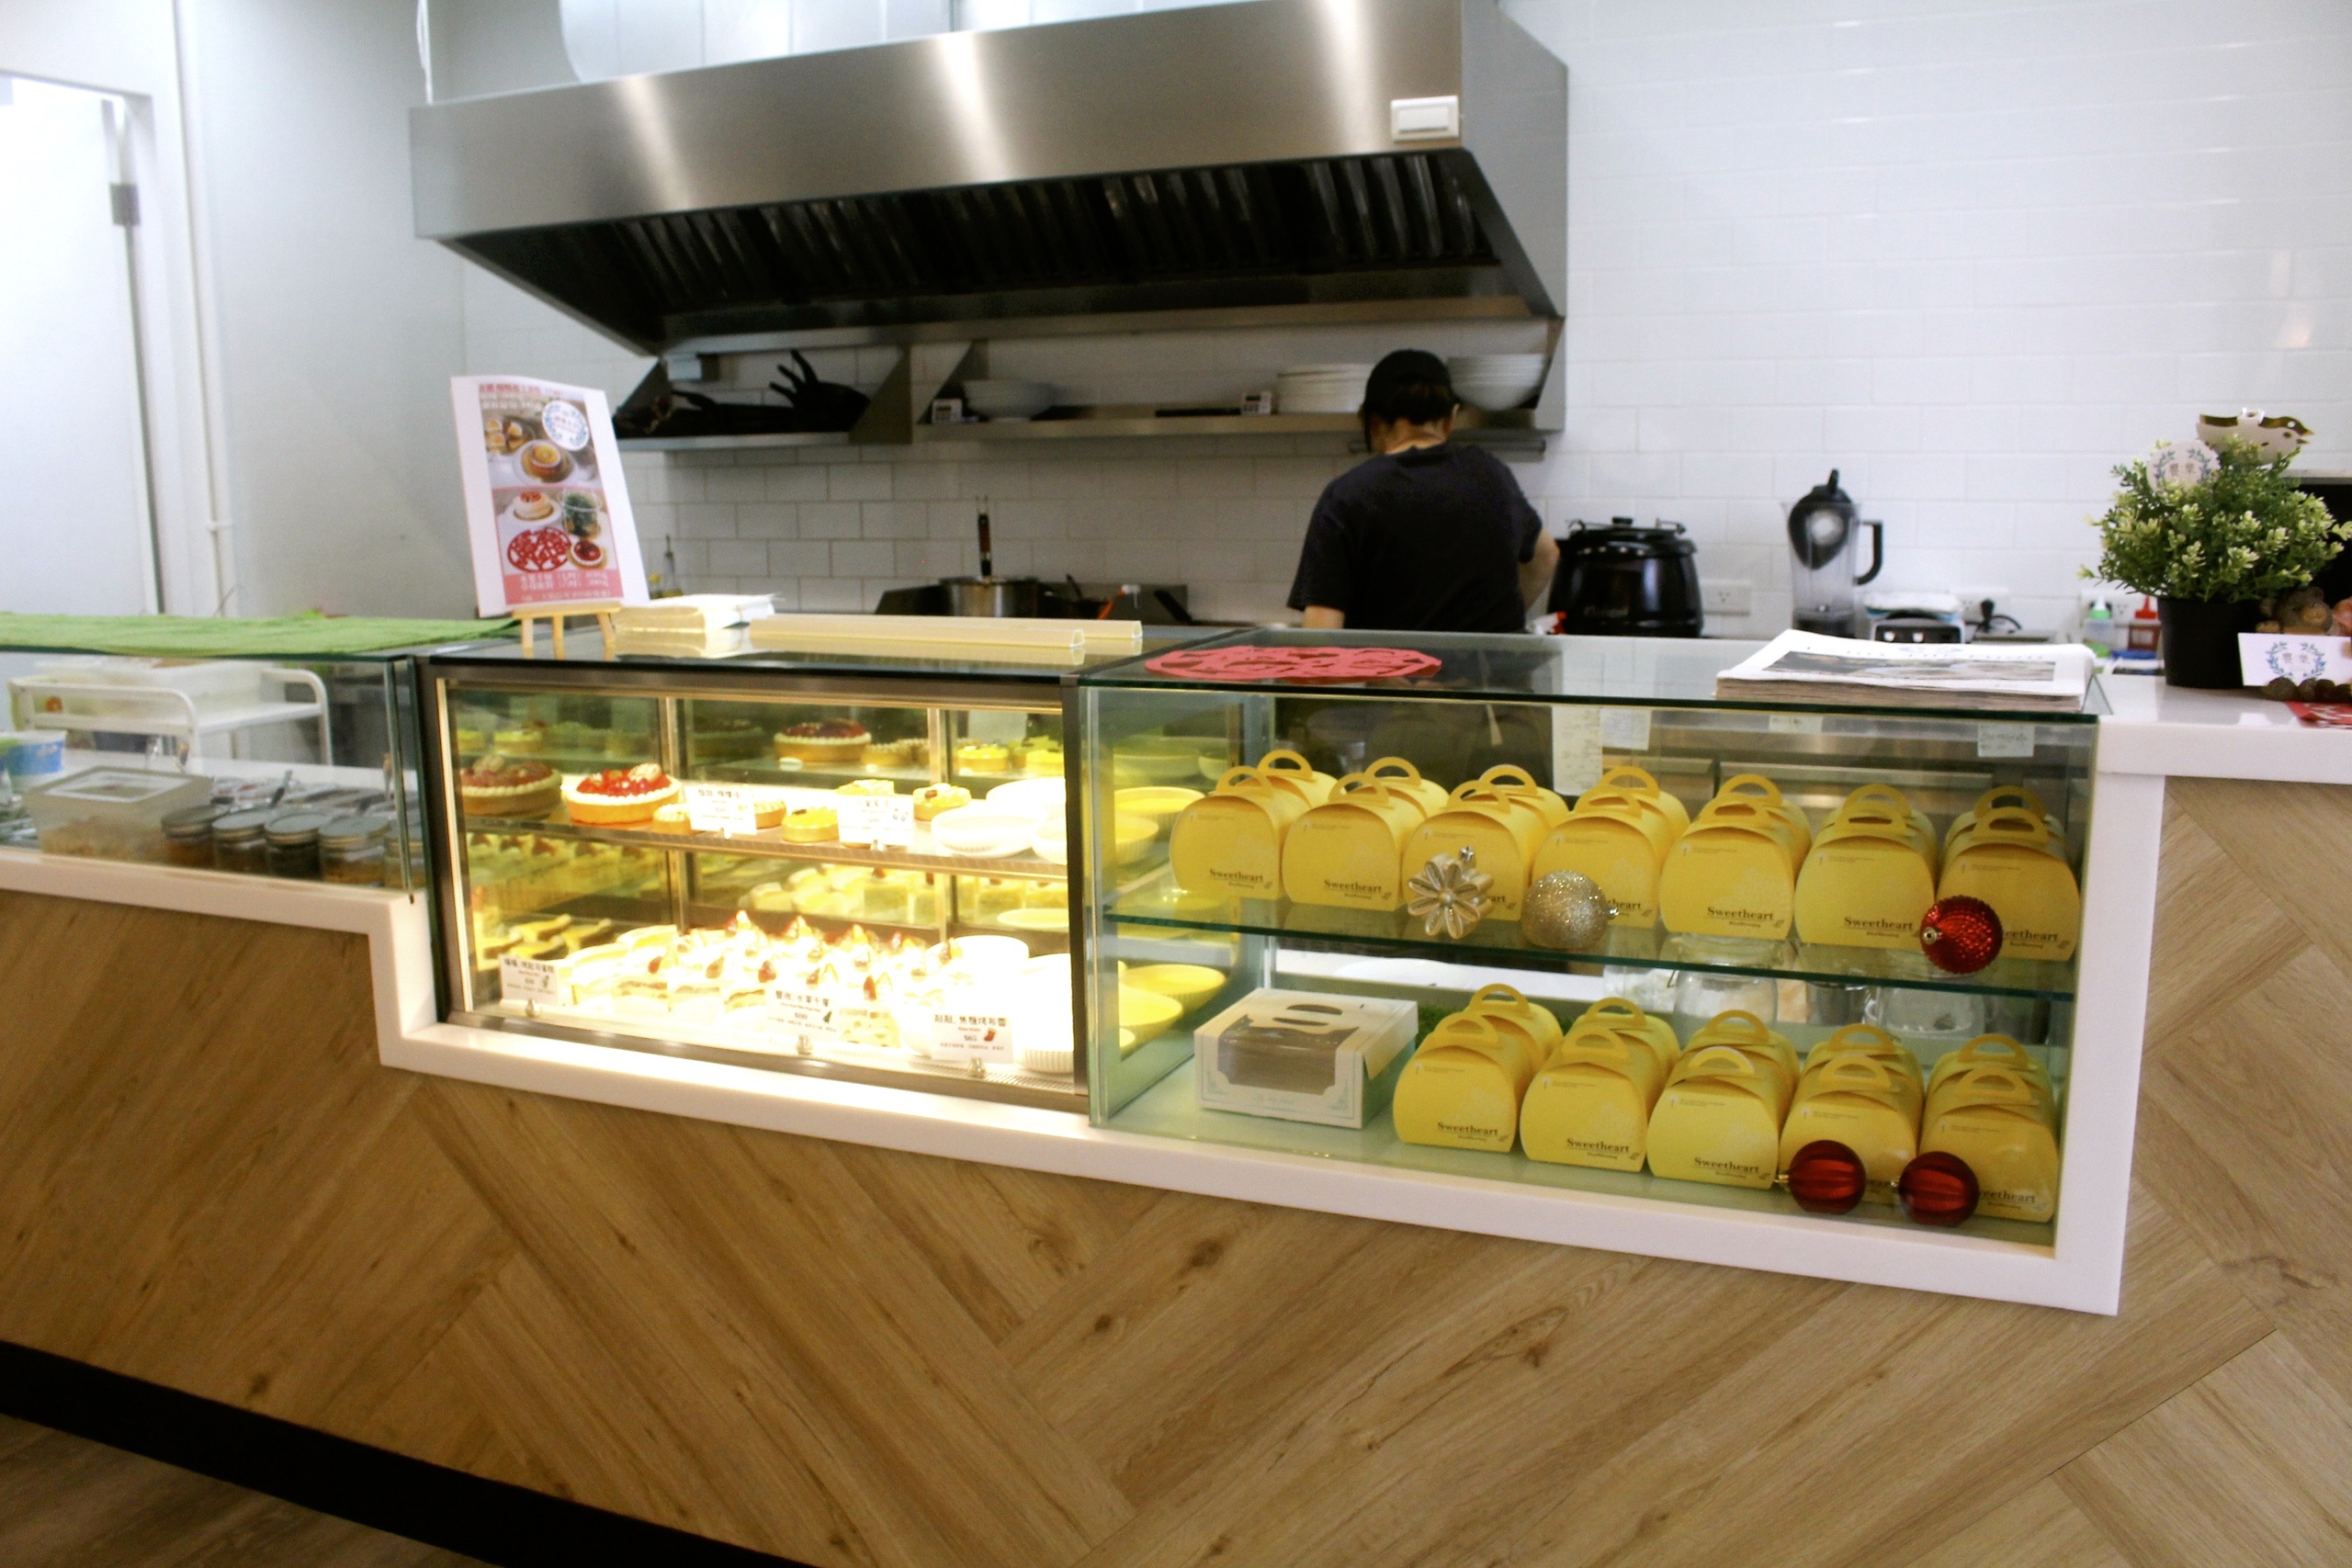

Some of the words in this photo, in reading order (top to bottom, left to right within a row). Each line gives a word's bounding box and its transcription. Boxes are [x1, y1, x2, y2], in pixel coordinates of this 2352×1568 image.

[1209, 868, 1263, 883] Sweetheart
[1324, 879, 1382, 893] Sweetheart
[1707, 907, 1773, 920] Sweetheart
[1844, 917, 1913, 930] Sweetheart
[2004, 930, 2058, 942] eetheart
[1437, 1122, 1498, 1136] Sweetheart
[1566, 1137, 1629, 1153] Sweetheart
[1694, 1156, 1758, 1173] Sweetheart
[1981, 1190, 2035, 1202] eetheart
